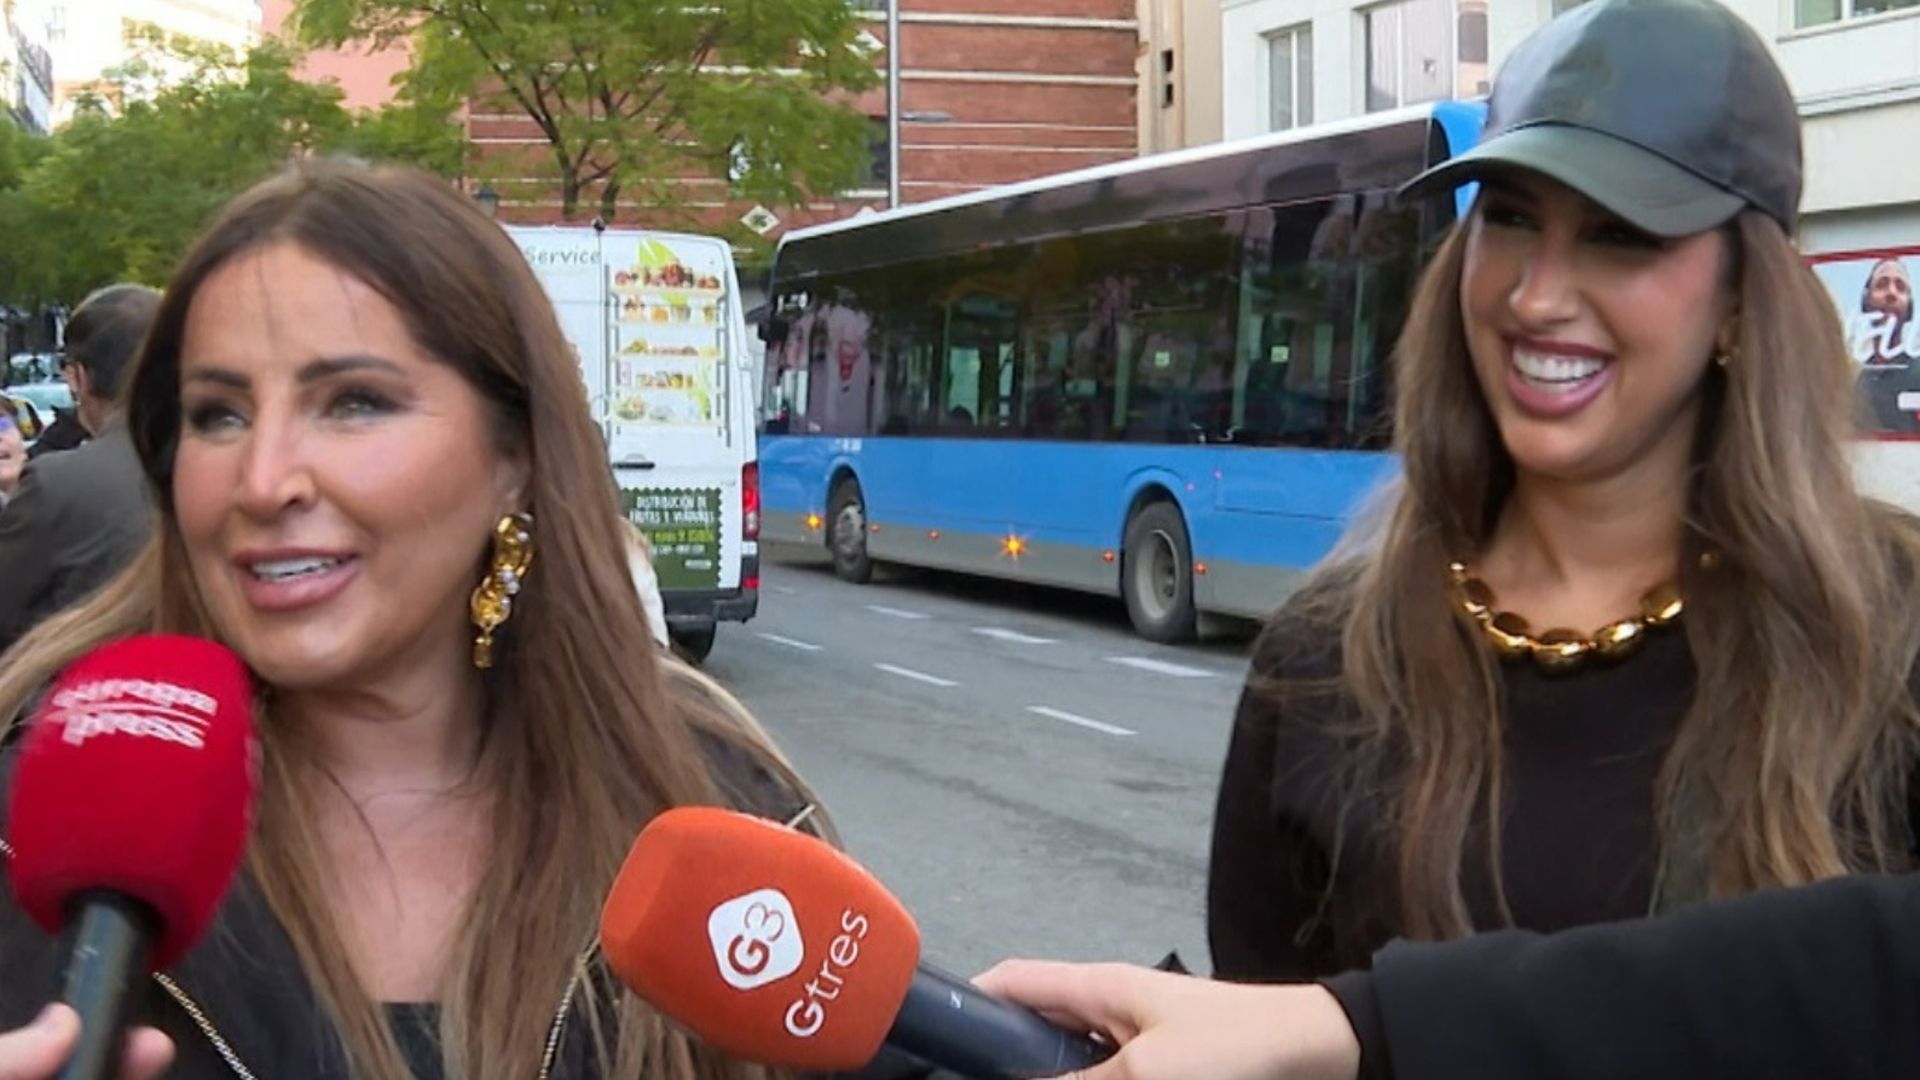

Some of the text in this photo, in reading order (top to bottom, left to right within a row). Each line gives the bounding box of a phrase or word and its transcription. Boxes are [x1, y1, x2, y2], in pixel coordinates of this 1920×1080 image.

[526, 245, 601, 264] Service
[727, 902, 786, 977] G3
[784, 908, 869, 1037] Gtres
